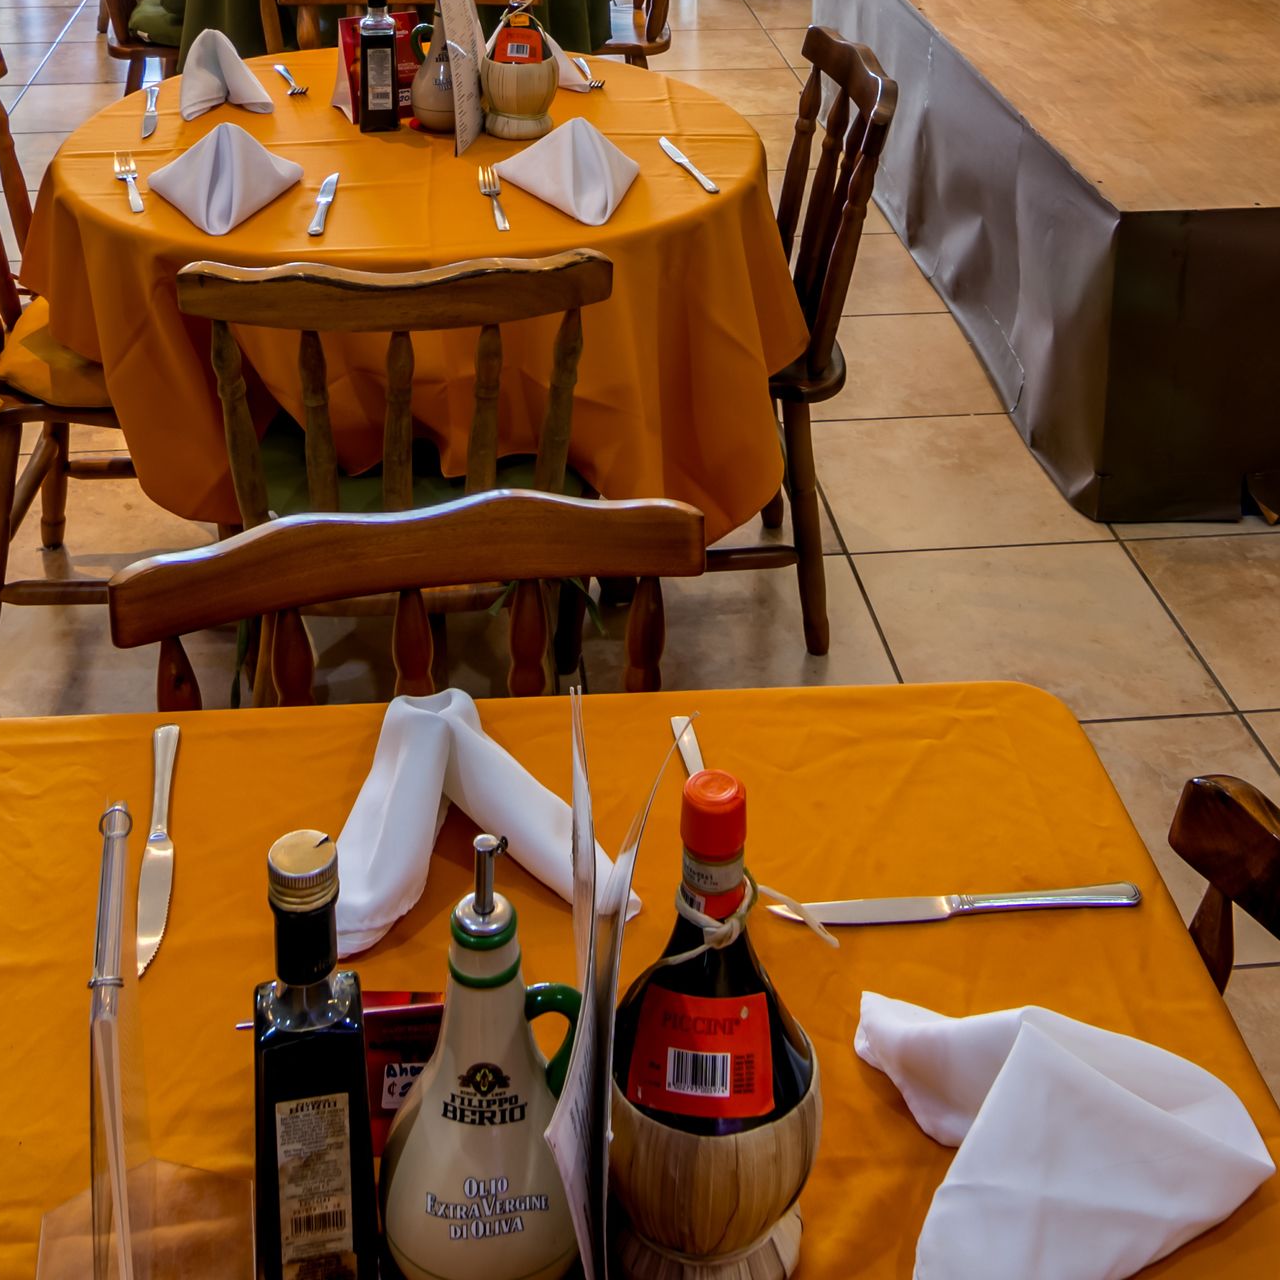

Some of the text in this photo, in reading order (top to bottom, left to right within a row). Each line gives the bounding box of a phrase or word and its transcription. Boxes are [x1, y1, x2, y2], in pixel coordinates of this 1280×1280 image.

[441, 1100, 526, 1126] BERIO
[451, 1093, 518, 1109] FILIPPO
[463, 1176, 509, 1199] OLIO
[425, 1192, 549, 1220] EXTRA VERGINE
[470, 1216, 524, 1240] OLIVA
